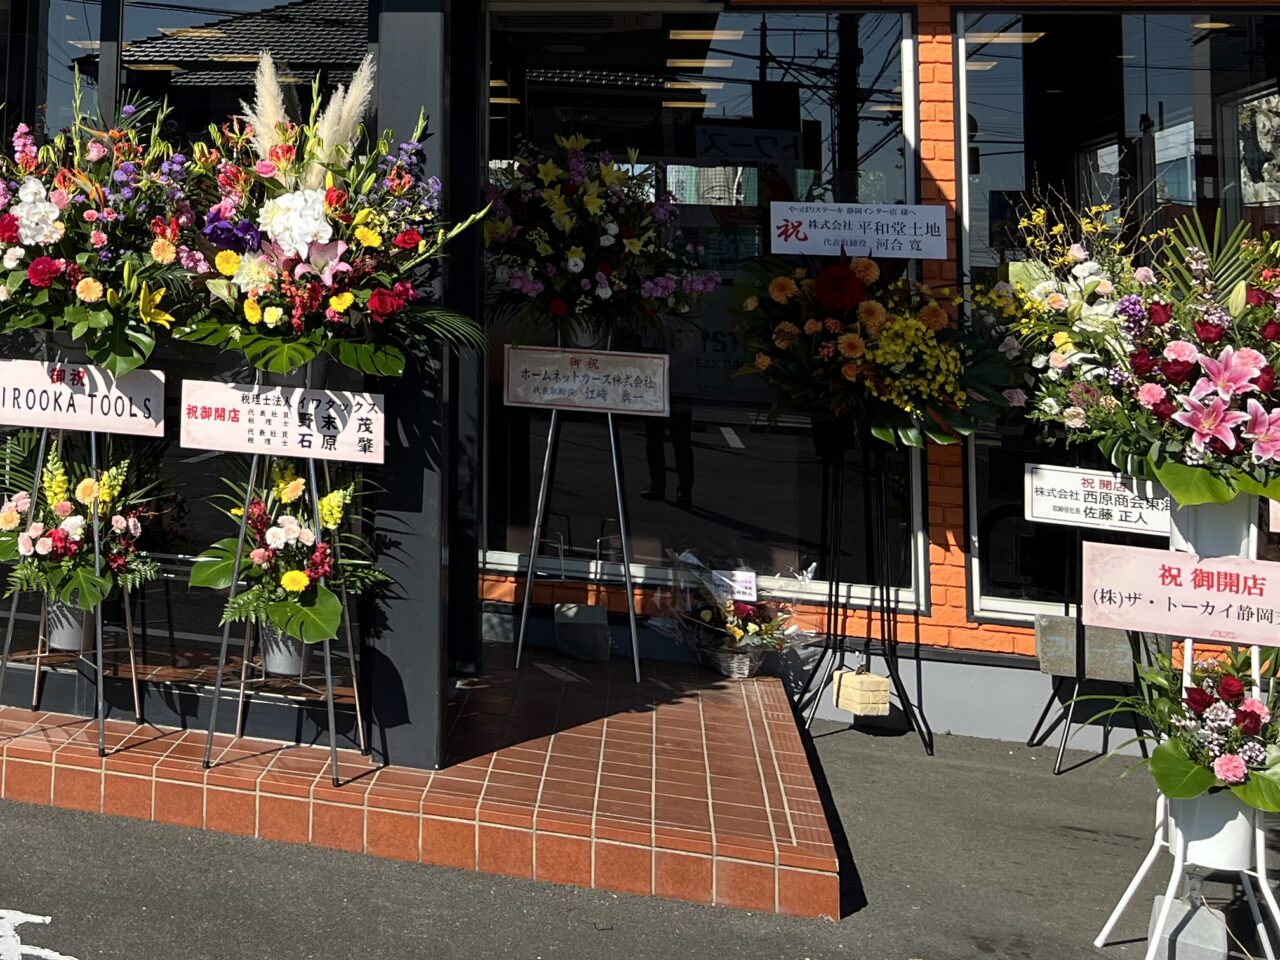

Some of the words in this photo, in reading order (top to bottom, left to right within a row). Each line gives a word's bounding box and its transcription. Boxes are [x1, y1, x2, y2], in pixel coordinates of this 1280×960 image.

[788, 206, 844, 215] やっぱりステーキ
[846, 206, 898, 216] 静岡インター店
[900, 208, 917, 217] 様へ
[775, 218, 809, 243] 祝
[808, 218, 854, 232] 株式会社
[858, 220, 942, 238] 平和堂土地
[823, 238, 868, 248] 代表取締役
[875, 239, 904, 252] 河合
[569, 356, 600, 370] 御祝
[49, 367, 88, 388] 御祝
[87, 393, 152, 420] TOOLS
[240, 392, 293, 409] 税理士法人
[185, 403, 241, 423] 祝御開店
[1034, 485, 1080, 501] 株式会社
[1083, 505, 1113, 521] 佐藤
[1118, 509, 1148, 525] 正人
[1158, 563, 1183, 589] 祝
[1189, 567, 1267, 597] 御開店
